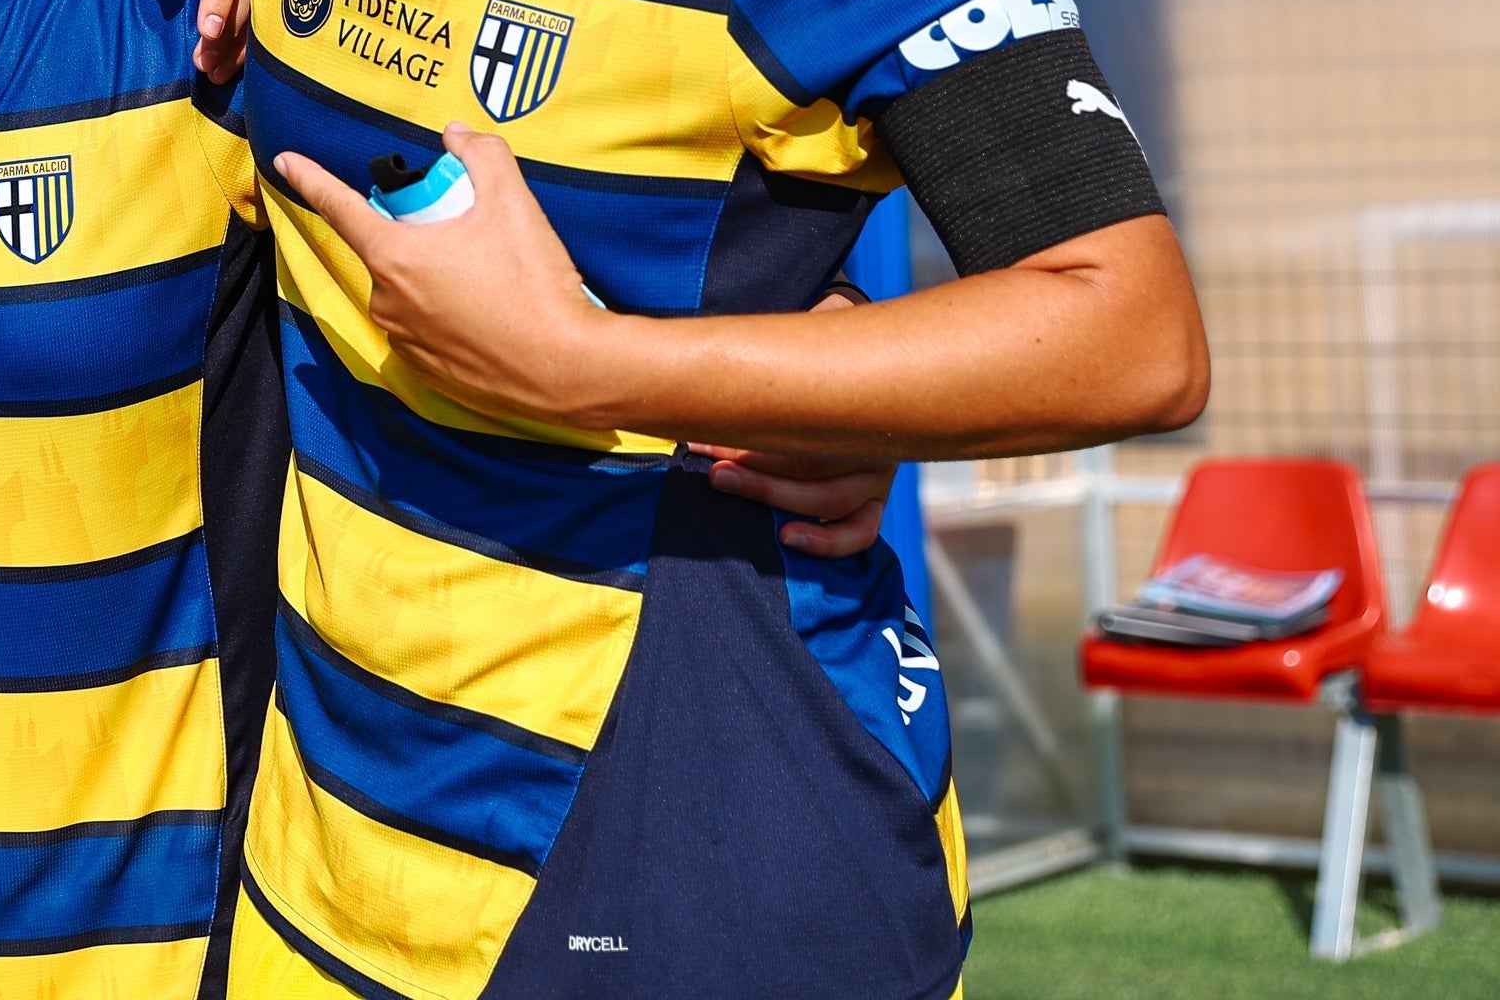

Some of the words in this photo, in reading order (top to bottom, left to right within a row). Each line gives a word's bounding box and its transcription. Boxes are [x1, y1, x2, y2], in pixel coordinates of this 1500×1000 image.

[490, 1, 526, 22] PARMA
[528, 12, 568, 33] CALCIO
[336, 18, 445, 88] VILLAGE
[33, 160, 67, 174] CALCIO
[568, 935, 629, 951] DRYCELL
